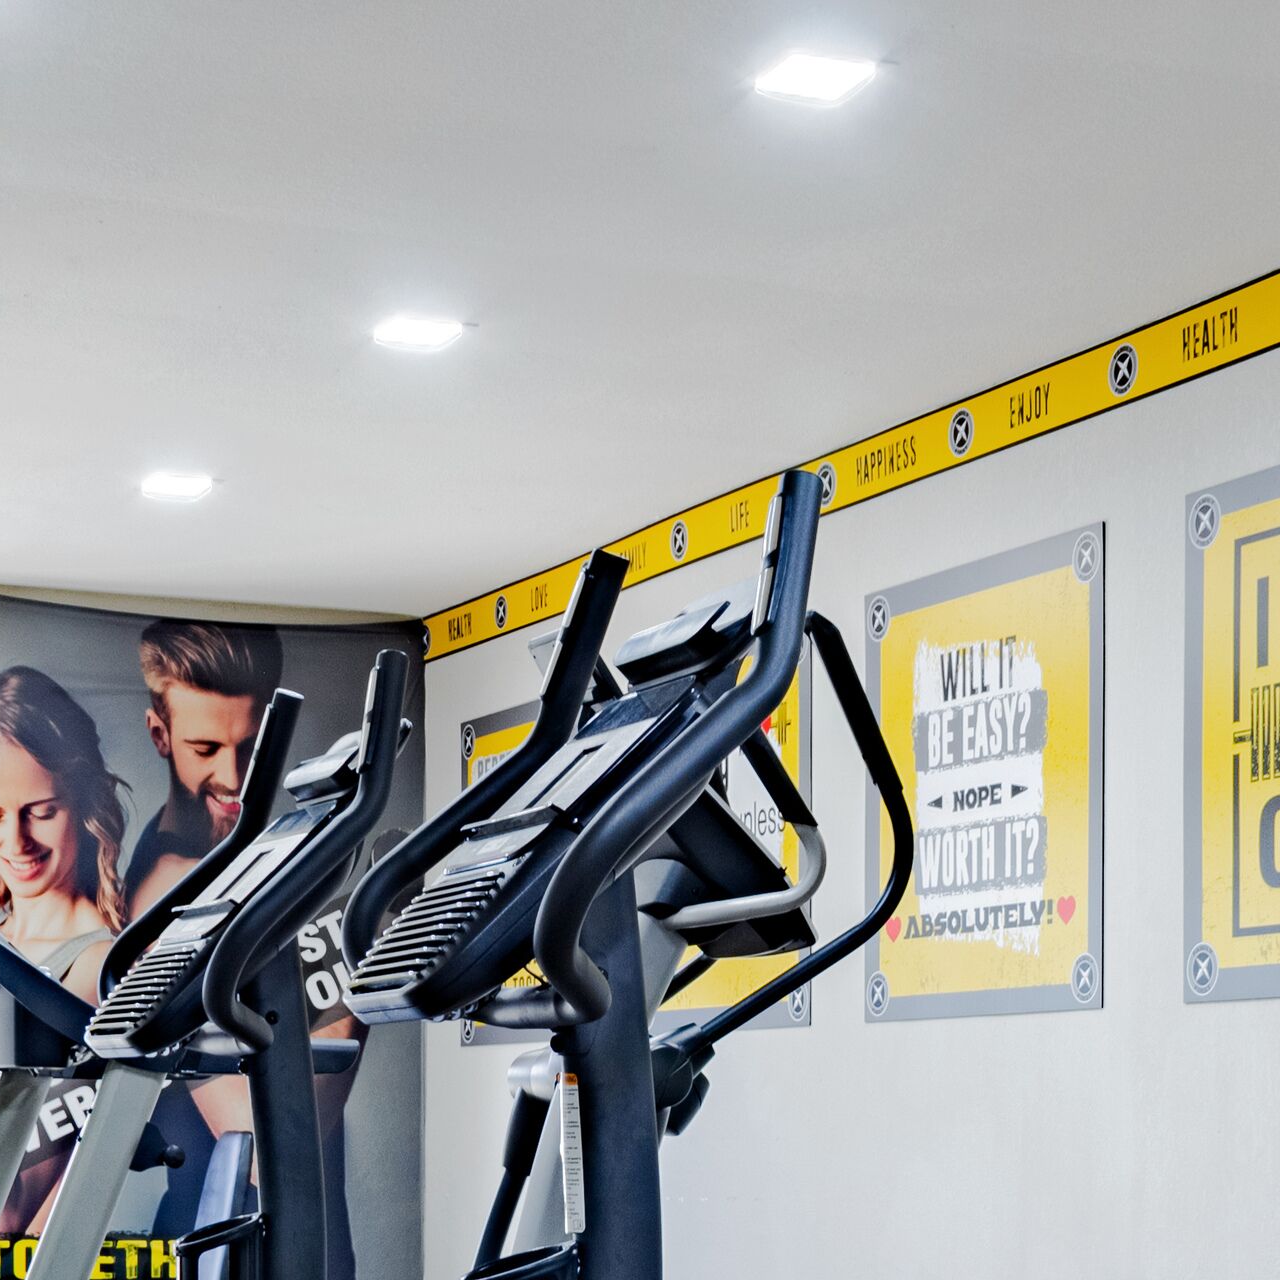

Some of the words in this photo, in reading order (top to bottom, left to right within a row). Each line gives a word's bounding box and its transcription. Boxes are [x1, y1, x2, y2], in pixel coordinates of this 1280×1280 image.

[1181, 306, 1239, 364] HEALTH
[1009, 382, 1051, 430] ENJOY
[855, 435, 918, 487] HAPPINESS
[729, 500, 750, 533] LIFE
[530, 582, 549, 613] LOVE
[1256, 575, 1270, 669] I
[447, 612, 472, 643] HEALTH
[940, 641, 990, 702] WILL
[999, 635, 1017, 690] IT
[927, 706, 955, 769] BE
[961, 691, 1032, 763] EASY?
[952, 782, 1003, 813] NOPE
[919, 822, 996, 890] WORTH
[1004, 817, 1041, 879] IT?
[903, 898, 1054, 940] ABSOLUTELY!
